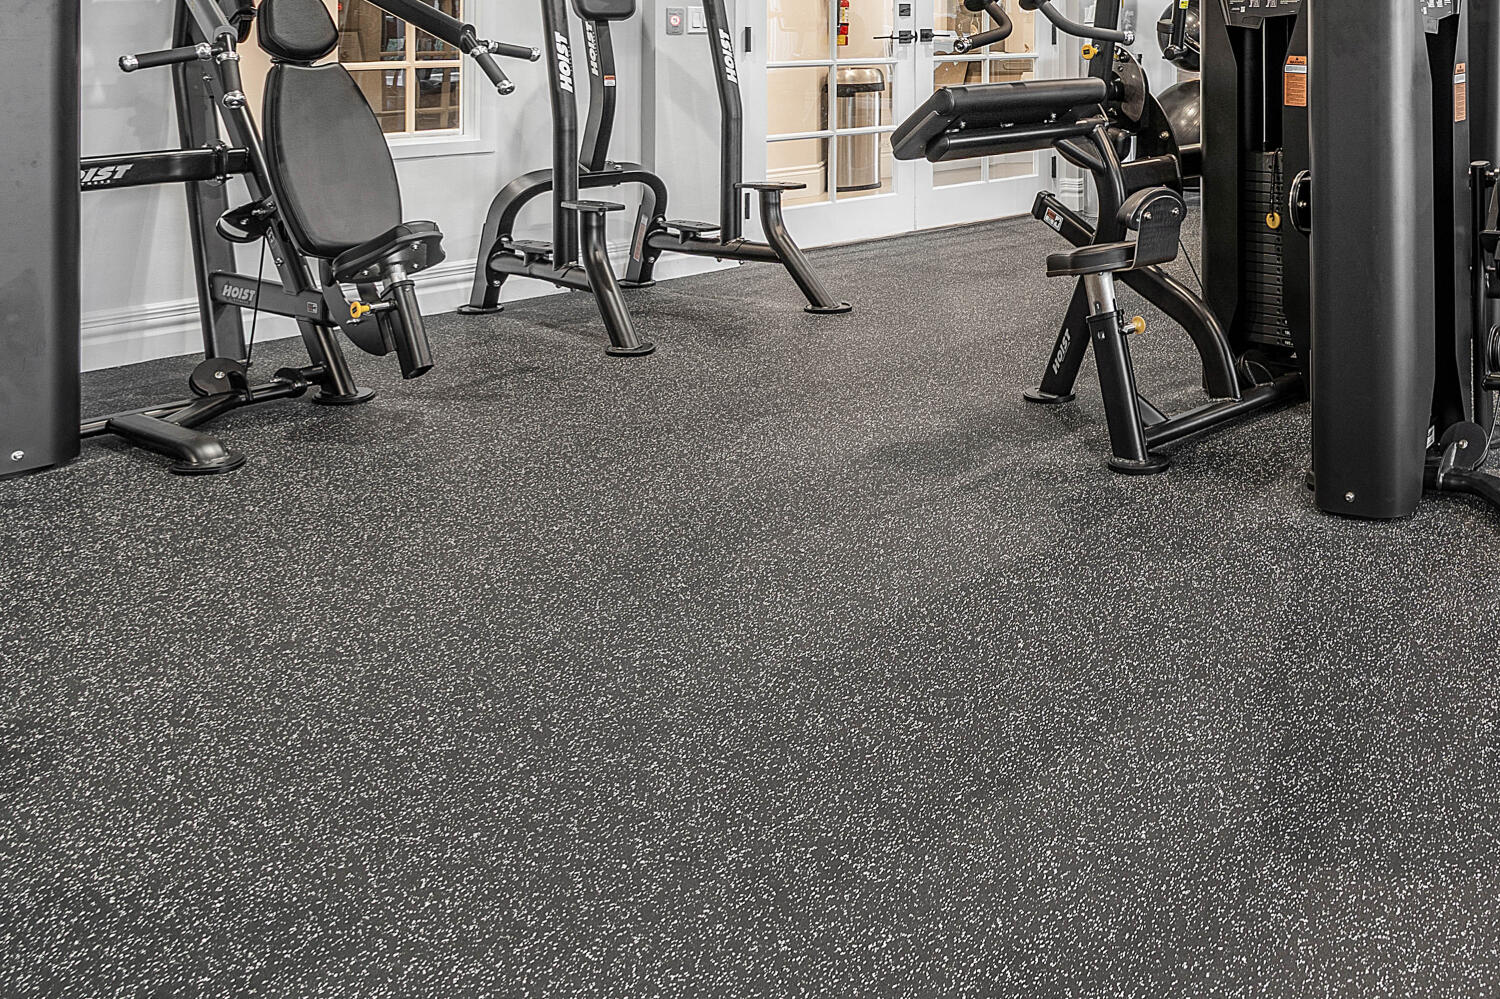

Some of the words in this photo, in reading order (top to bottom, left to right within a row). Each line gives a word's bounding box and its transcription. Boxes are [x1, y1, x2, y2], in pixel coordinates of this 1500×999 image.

[554, 31, 574, 94] HOIST
[585, 20, 599, 76] HOIST
[719, 28, 737, 83] HOIST
[80, 163, 134, 183] IST
[222, 284, 256, 301] HOIST
